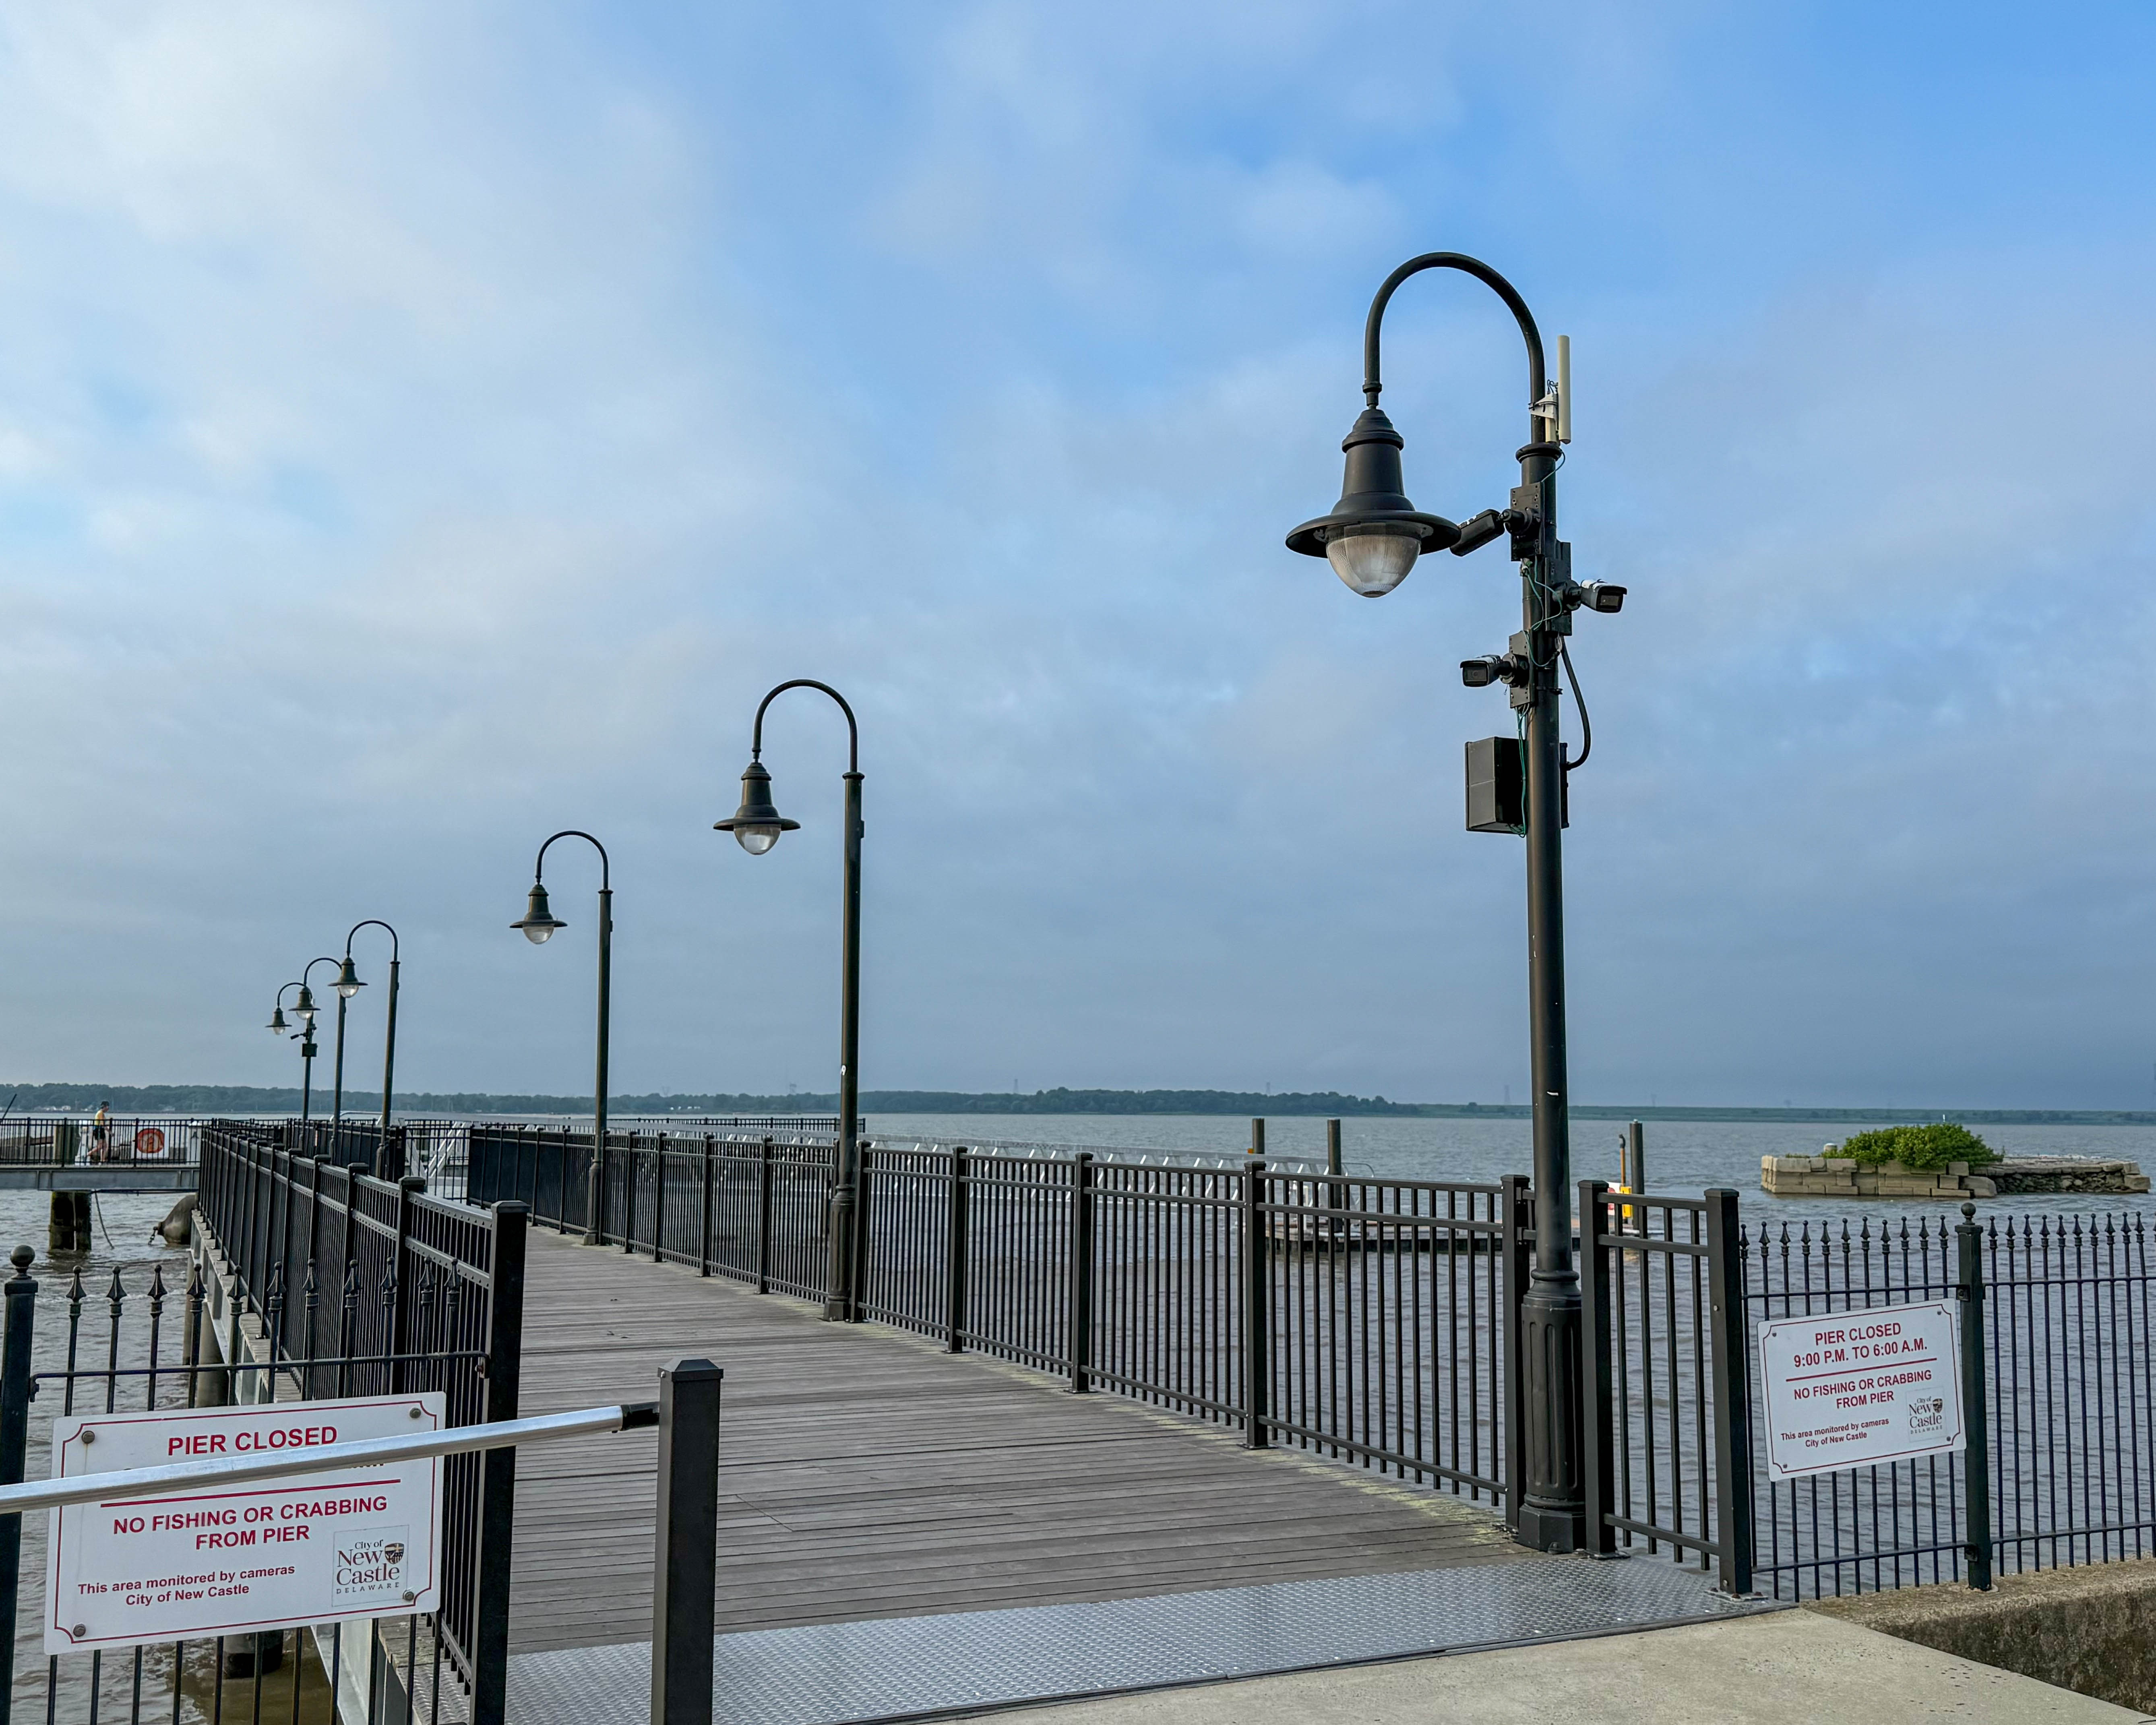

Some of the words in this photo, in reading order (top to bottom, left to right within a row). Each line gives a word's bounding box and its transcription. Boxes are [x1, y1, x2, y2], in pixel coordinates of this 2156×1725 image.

[1815, 1330, 1845, 1346] PIER
[1849, 1323, 1901, 1341] CLOSED
[1794, 1352, 1820, 1367] 9:00
[1824, 1349, 1848, 1363] P.M.
[1852, 1345, 1869, 1359] TO
[1873, 1342, 1898, 1356] 6:00
[1902, 1338, 1927, 1353] A.M.
[1794, 1388, 1810, 1400] NO
[1813, 1381, 1856, 1397] FISHING
[1859, 1378, 1874, 1390] OR
[1877, 1370, 1932, 1387] CRABBING
[1836, 1394, 1867, 1409] FROM
[1870, 1391, 1894, 1404] PIER
[1909, 1403, 1933, 1416] New
[1781, 1432, 1796, 1441] This
[1815, 1423, 1849, 1435] monitored
[1851, 1423, 1858, 1431] by
[1861, 1419, 1889, 1428] cameras
[1910, 1412, 1942, 1428] Castle
[168, 1434, 227, 1456] PIER
[235, 1426, 337, 1451] CLOSED
[1805, 1440, 1819, 1448] City
[1821, 1437, 1827, 1445] of
[1846, 1431, 1867, 1440] Castle
[114, 1517, 145, 1535] NO
[152, 1509, 237, 1531] FISHING
[244, 1506, 274, 1523] OR
[281, 1496, 387, 1519] CRABBING
[196, 1530, 256, 1550] FROM
[263, 1525, 310, 1543] PIER
[355, 1541, 372, 1550] City
[374, 1539, 383, 1547] of
[337, 1549, 383, 1567] New
[78, 1582, 107, 1595] This
[112, 1581, 141, 1592] area
[146, 1571, 215, 1588] monitored
[220, 1571, 236, 1583] by
[240, 1566, 295, 1579] cameras
[337, 1563, 400, 1585] Castle
[126, 1594, 153, 1606] City
[157, 1591, 172, 1602] of
[175, 1590, 204, 1601] New
[208, 1584, 249, 1597] Castle
[336, 1582, 399, 1594] DELAWARE
